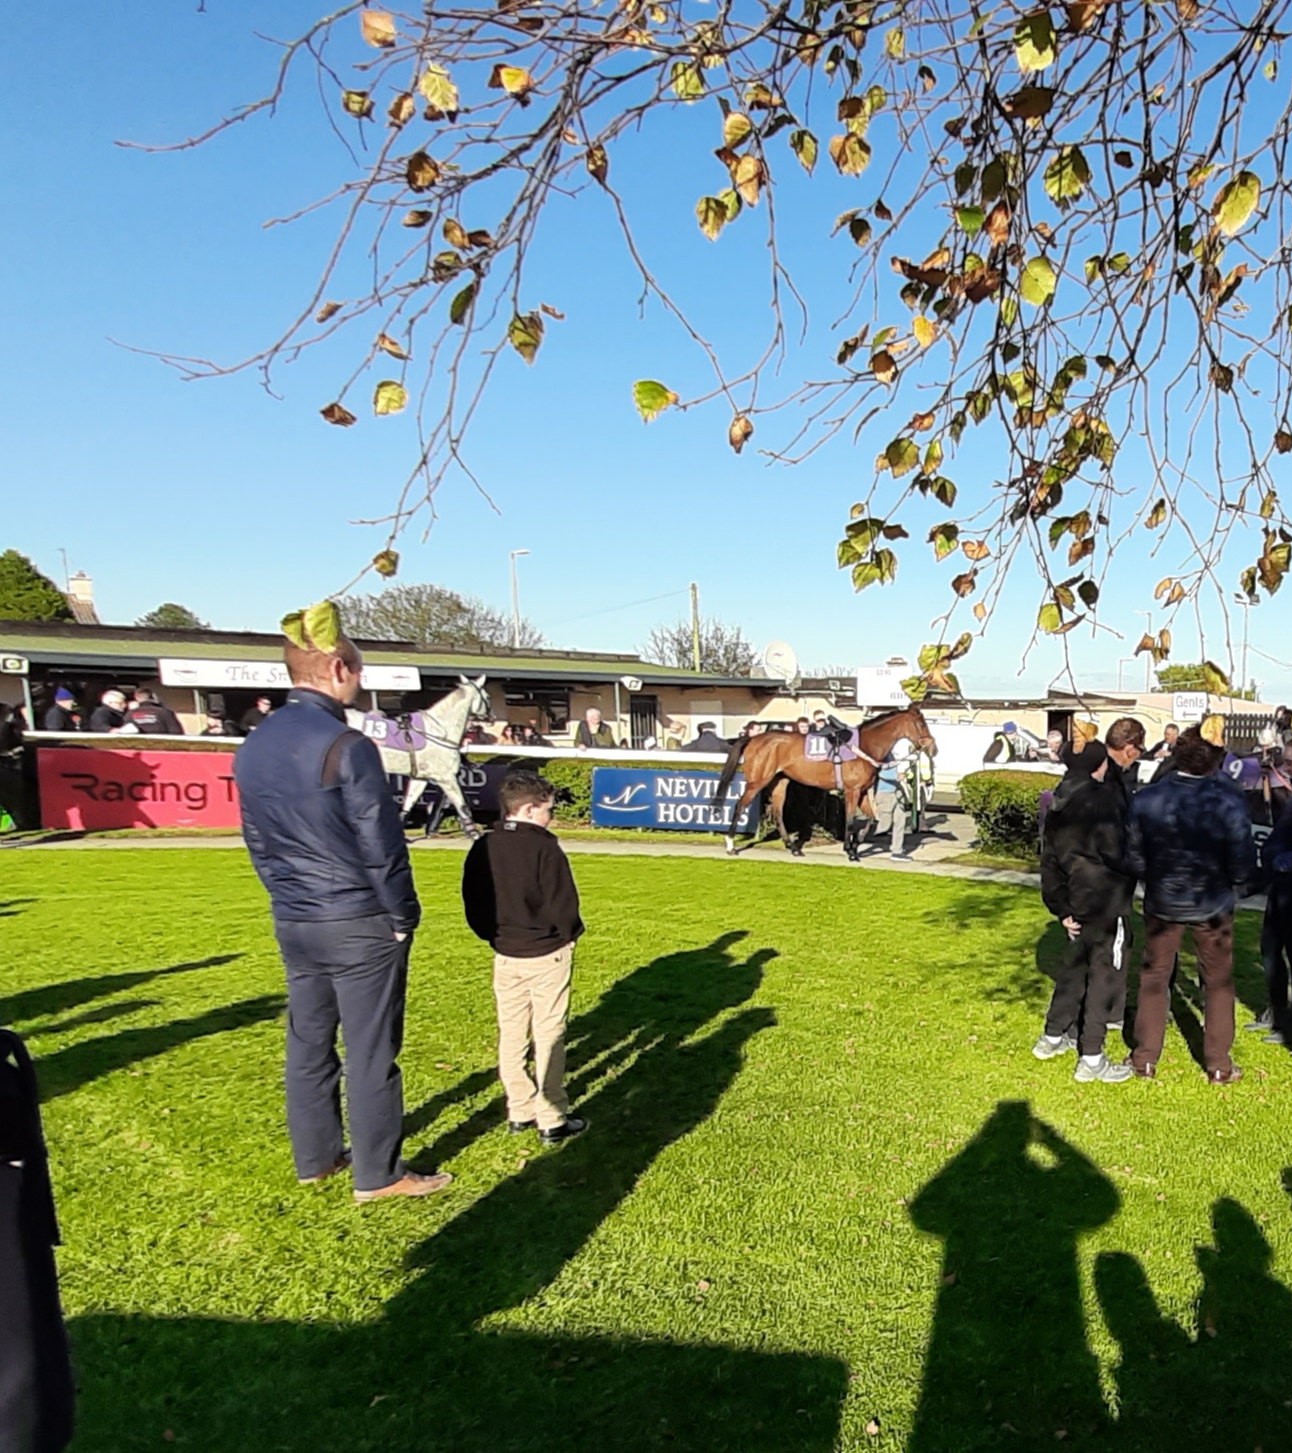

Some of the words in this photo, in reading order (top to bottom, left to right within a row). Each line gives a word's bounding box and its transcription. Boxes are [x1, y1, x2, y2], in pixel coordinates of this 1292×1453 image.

[225, 665, 259, 682] The
[1176, 695, 1205, 708] Gents
[365, 719, 387, 740] 13
[808, 737, 828, 755] 11
[1229, 759, 1244, 780] 9
[61, 773, 208, 811] Racing
[216, 776, 235, 802] T
[658, 803, 749, 827] HOTELS
